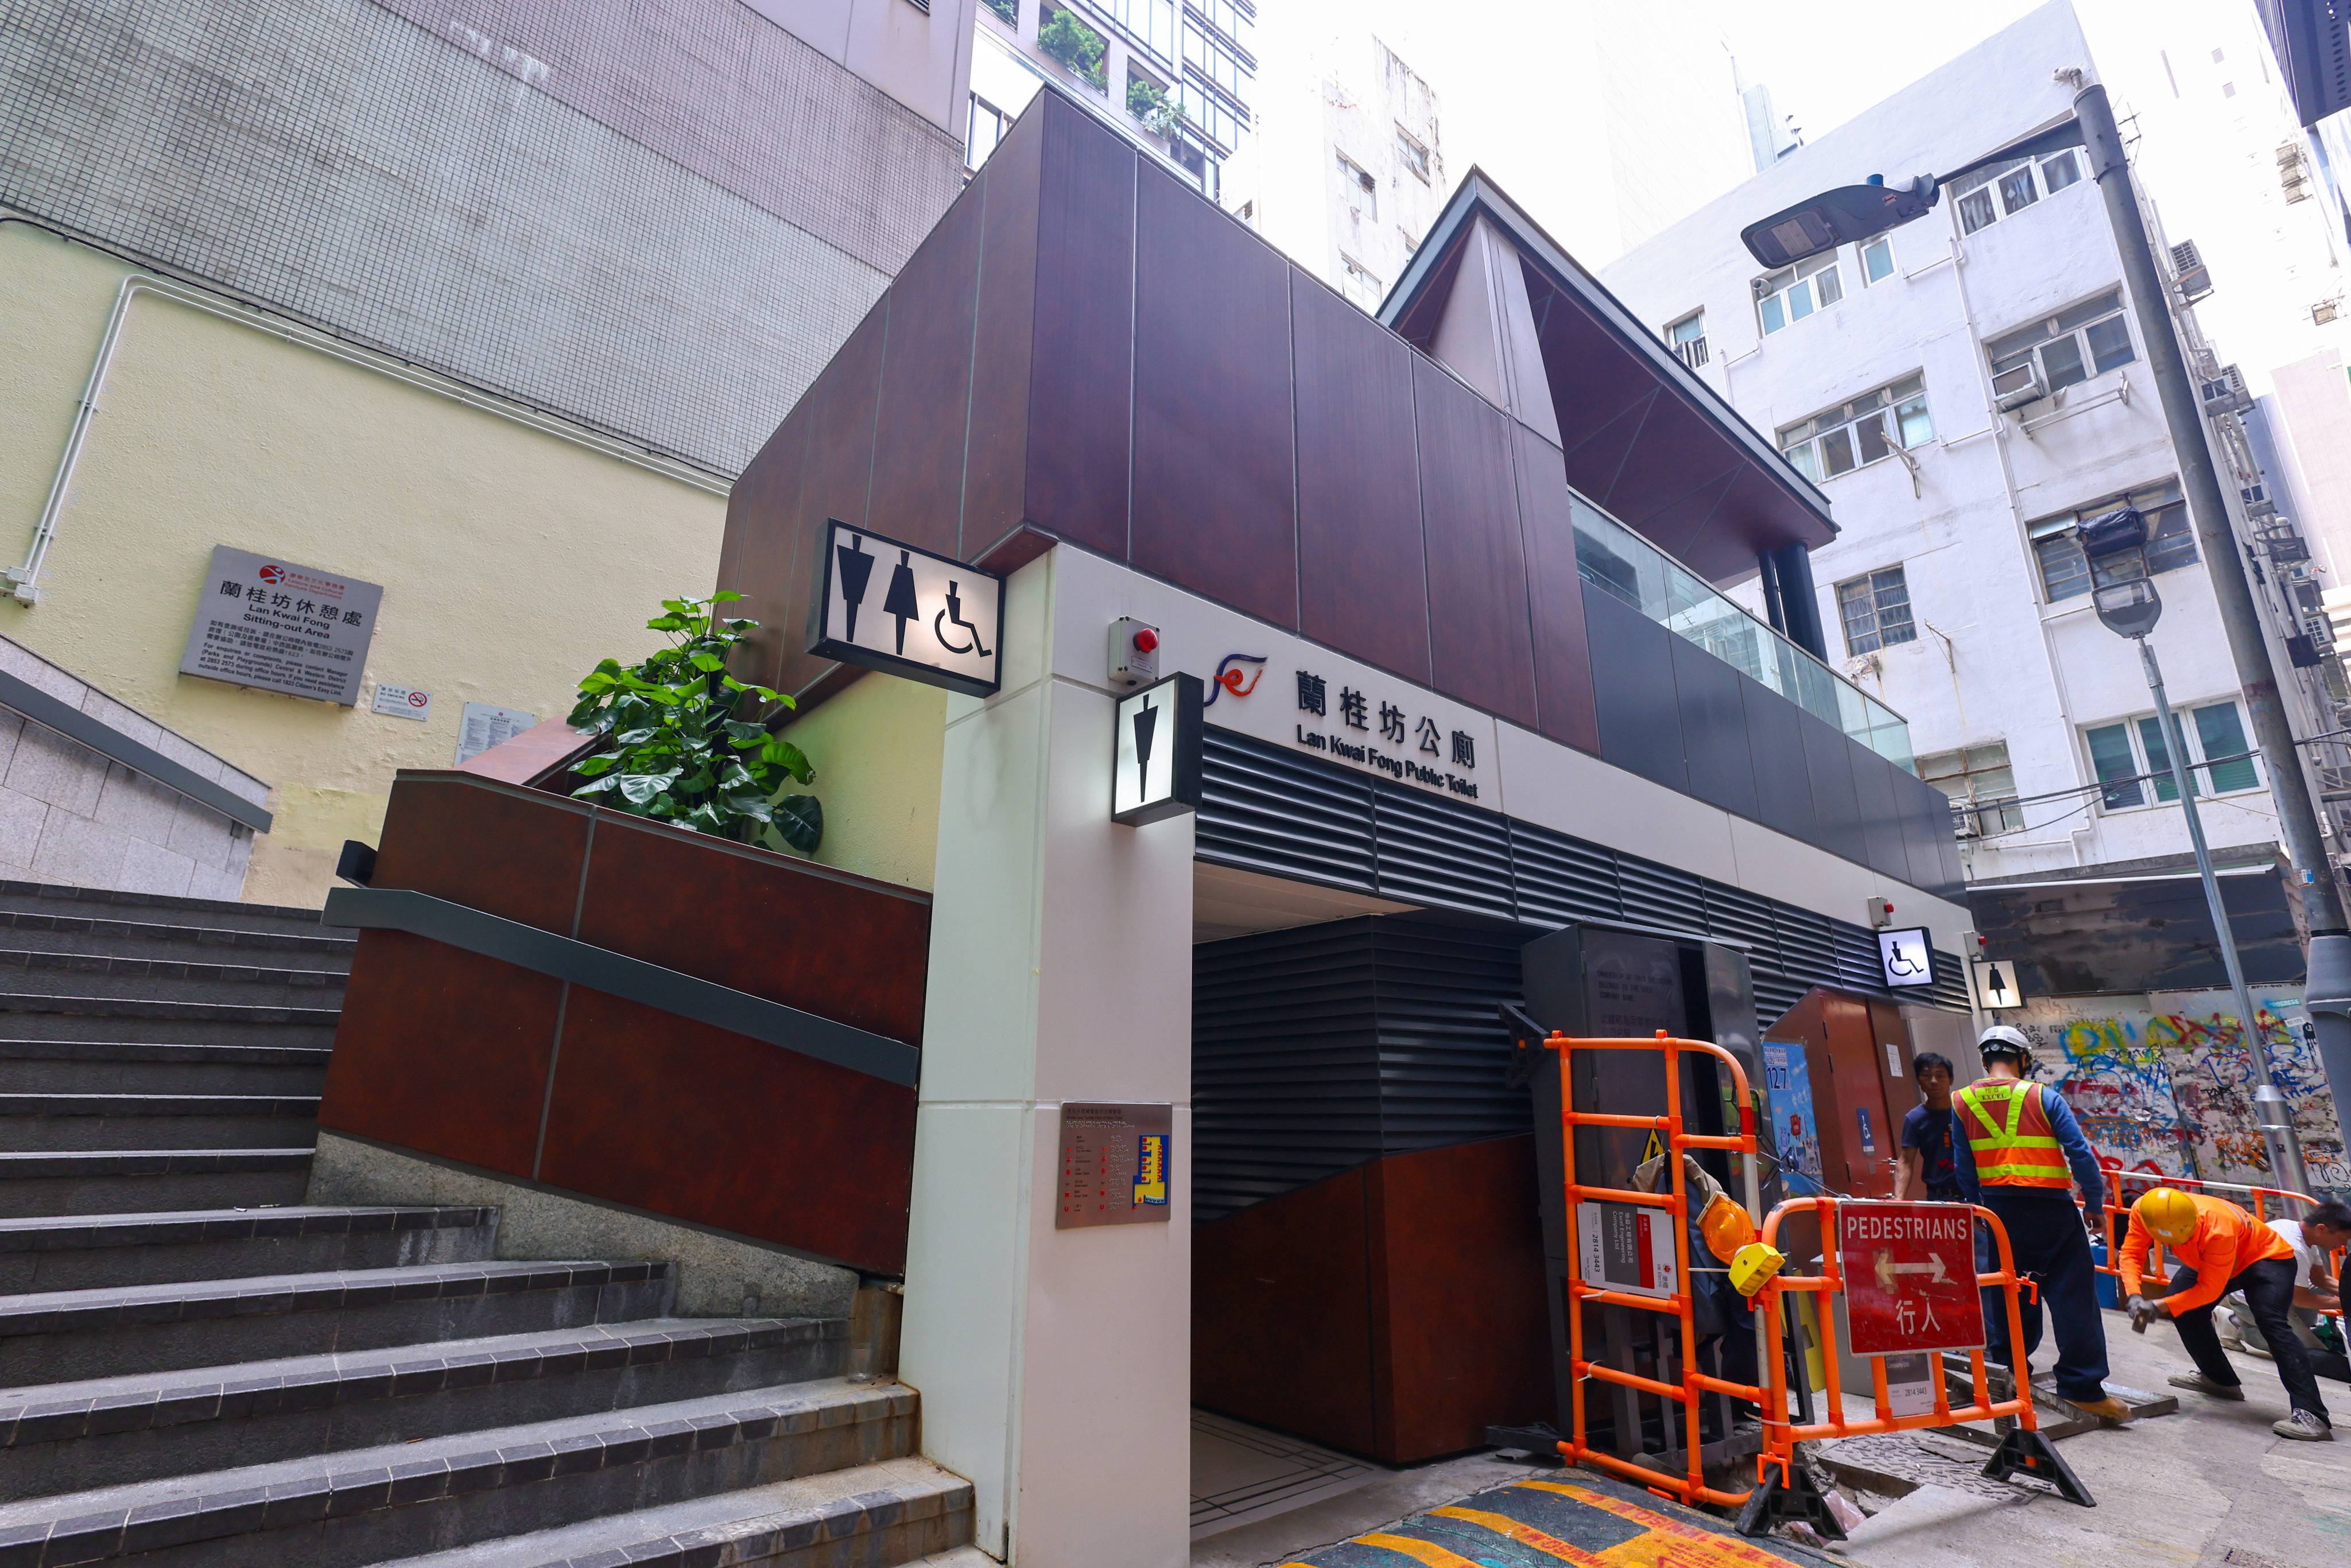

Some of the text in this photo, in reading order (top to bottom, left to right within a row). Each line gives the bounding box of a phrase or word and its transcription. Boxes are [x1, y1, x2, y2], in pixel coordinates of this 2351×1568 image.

[219, 579, 363, 627] 蘭桂坊休憩處
[242, 612, 331, 639] Sitting-out Area
[249, 604, 330, 630] Lan Kwai Fong
[197, 662, 219, 671] outside
[253, 674, 271, 682] please
[216, 645, 242, 655] enquiries
[285, 660, 302, 668] please
[326, 668, 348, 677] Manager
[275, 664, 294, 672] Central
[304, 670, 325, 678] Western
[328, 675, 346, 683] District
[235, 663, 253, 672] during
[318, 680, 344, 689] assistance
[1296, 670, 1475, 769] 蘭桂坊公廁
[1297, 724, 1478, 799] Lan Kwai Fong Public Toilet
[1597, 970, 1624, 980] OWNERSHIP
[1635, 975, 1646, 983] THIS
[1599, 980, 1619, 989] BELONGS
[1630, 984, 1640, 992] THE
[1641, 985, 1653, 993] USER
[1599, 991, 1620, 1000] COMPANY
[1847, 1216, 1967, 1240] PEDESTRIANS
[1895, 1297, 1941, 1336] 行人
[1905, 1388, 1915, 1396] 2814
[1917, 1387, 1927, 1396] 3443
